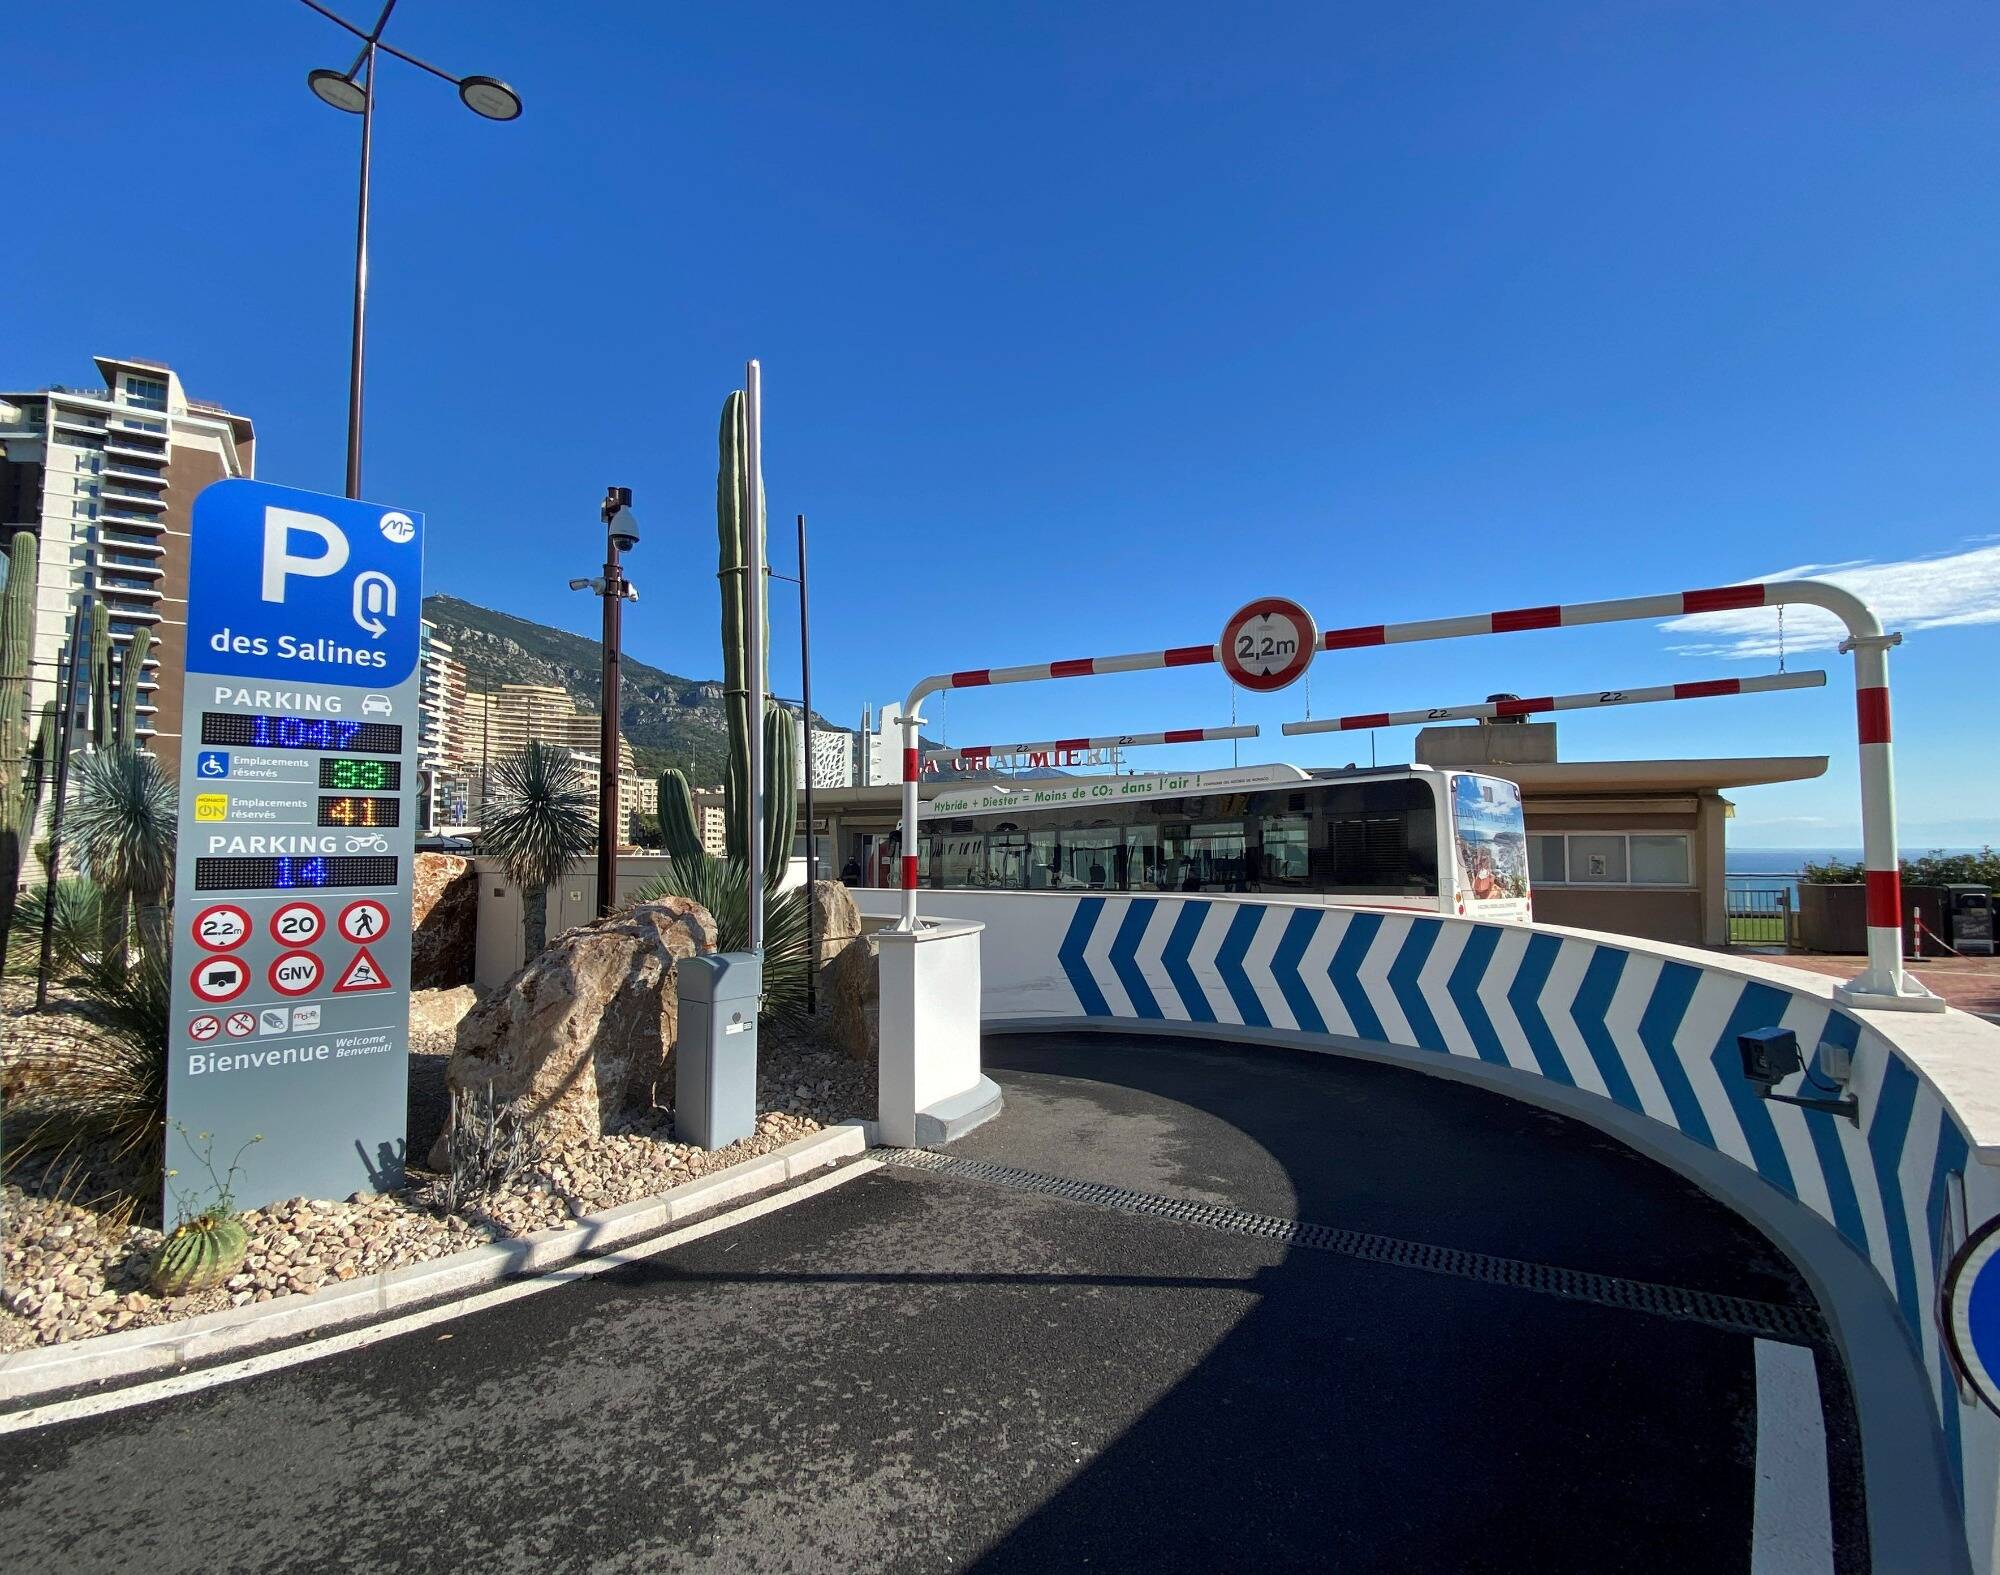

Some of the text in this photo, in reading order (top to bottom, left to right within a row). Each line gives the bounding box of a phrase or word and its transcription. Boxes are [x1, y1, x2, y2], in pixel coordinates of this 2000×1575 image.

[262, 506, 350, 604] P
[210, 628, 388, 669] des Salines
[214, 686, 343, 713] PARKING
[255, 715, 360, 748] 1047
[232, 768, 278, 778] réservés
[233, 756, 310, 768] Emplacements
[333, 760, 384, 788] 33
[231, 797, 308, 808] Emplacements
[934, 799, 968, 812] Hybride
[983, 796, 1019, 807] Diester
[1034, 791, 1067, 803] Moins
[1072, 788, 1086, 799] de
[1121, 782, 1152, 794] dans
[1160, 777, 1189, 791] l'air
[231, 810, 277, 819] réservés
[331, 798, 377, 827] 41
[209, 835, 337, 854] PARKING
[277, 857, 328, 886] 14
[281, 916, 315, 934] 20
[278, 965, 315, 981] GNV
[336, 1034, 387, 1048] Welcome
[336, 1042, 392, 1058] Benvenuti
[188, 1044, 330, 1076] Bienvenue
